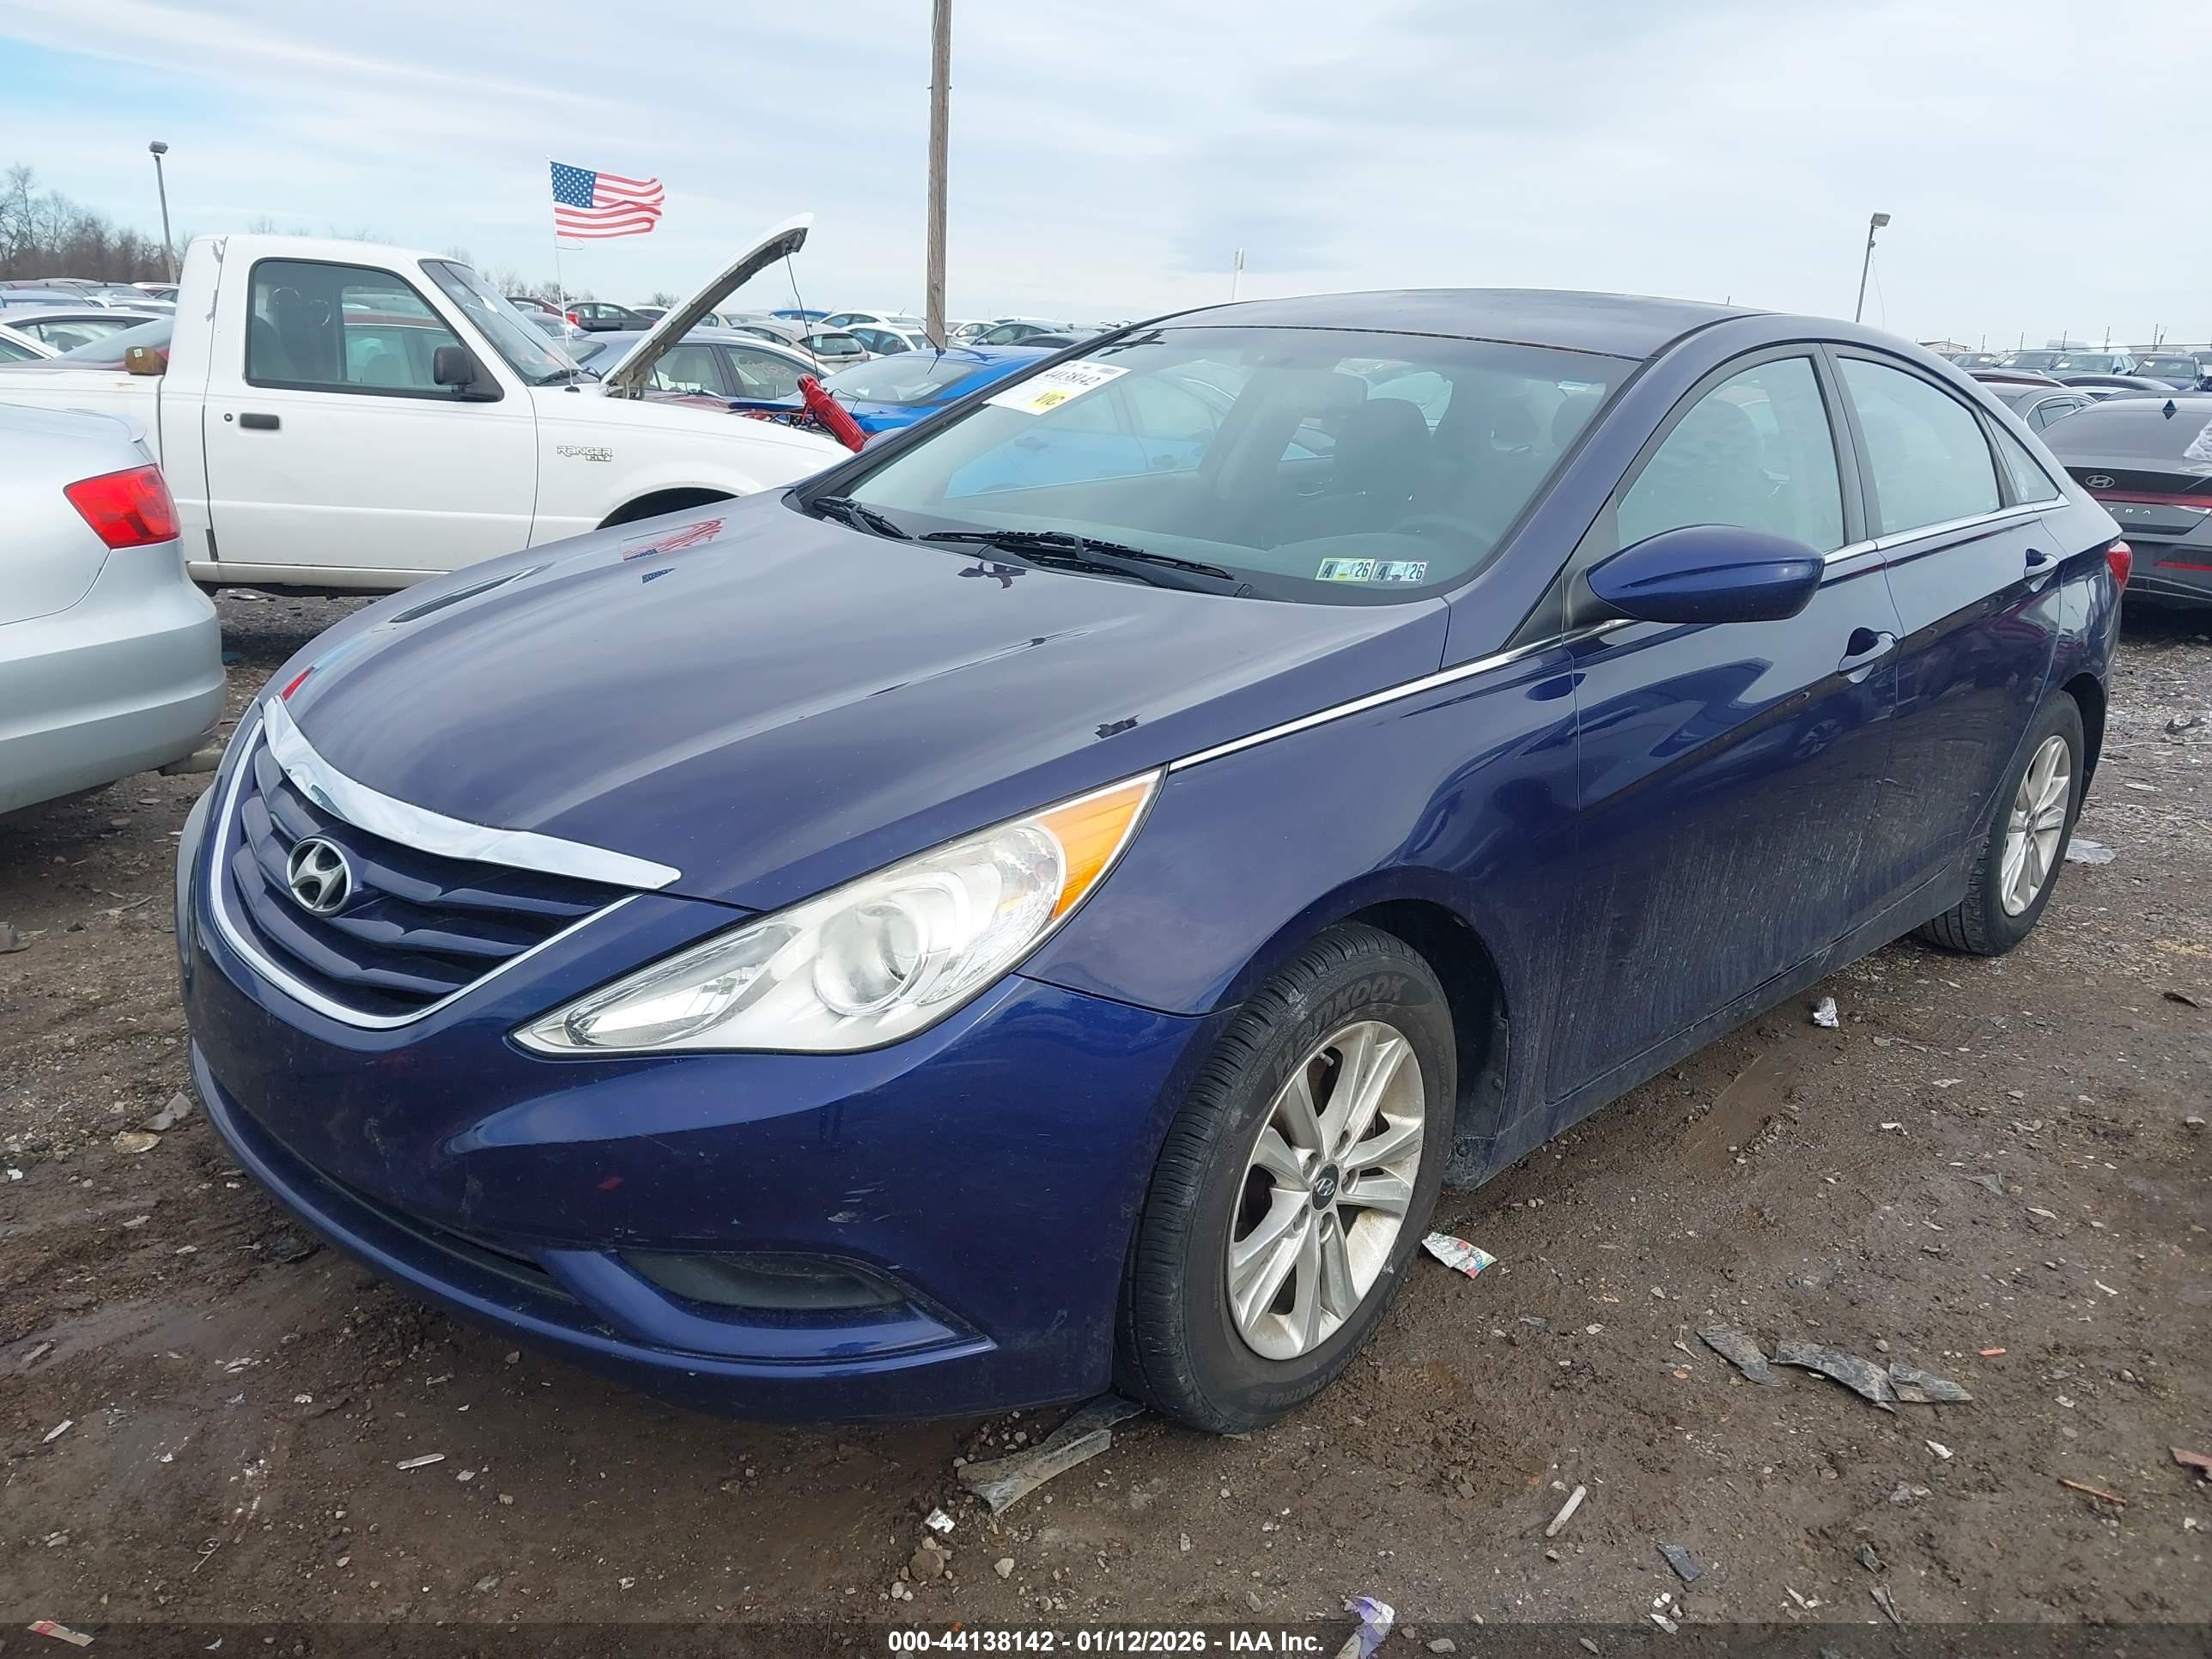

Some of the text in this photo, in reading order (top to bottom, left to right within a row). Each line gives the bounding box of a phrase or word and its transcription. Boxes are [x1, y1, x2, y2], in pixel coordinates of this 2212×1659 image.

[1035, 392, 1065, 406] VIC
[557, 446, 612, 457] RANGER
[1322, 562, 1371, 579] 4 26
[1376, 563, 1425, 580] 4 26
